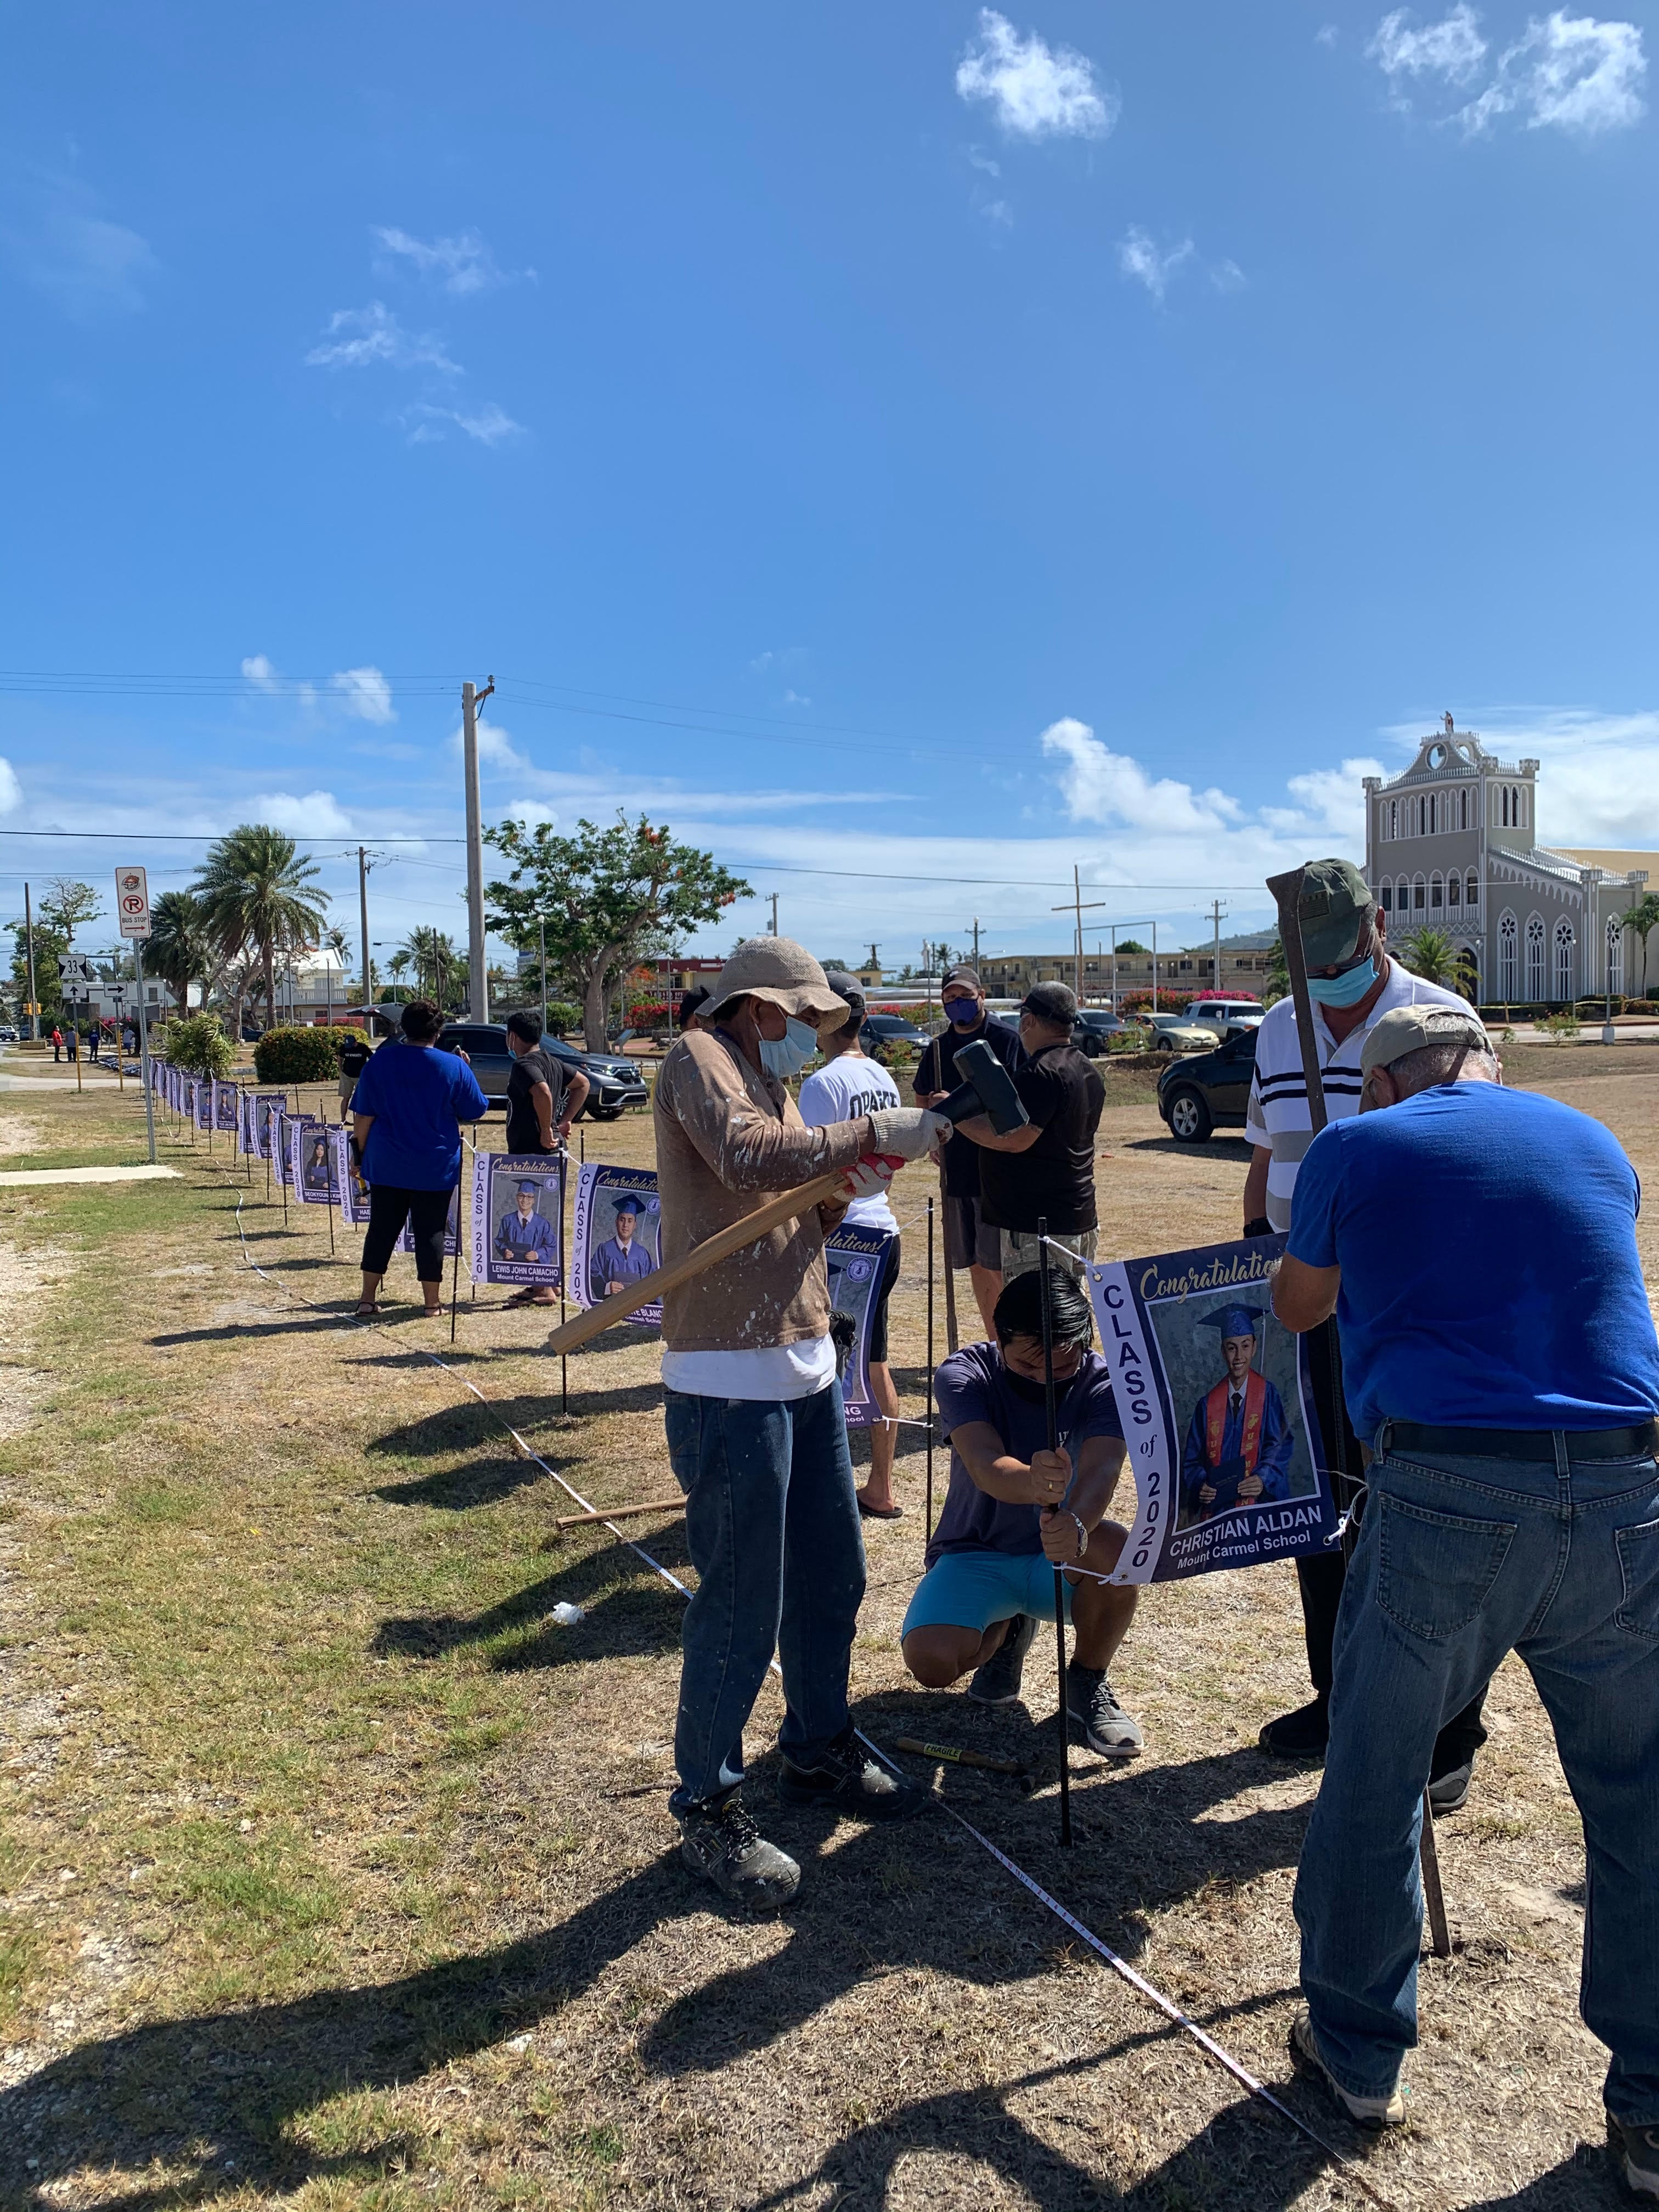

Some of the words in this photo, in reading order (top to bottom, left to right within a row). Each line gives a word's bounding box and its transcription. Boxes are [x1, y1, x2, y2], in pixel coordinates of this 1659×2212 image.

[67, 960, 78, 973] 33
[475, 1161, 485, 1215] CLASS
[475, 1218, 483, 1227] of
[577, 1173, 590, 1240] CLASS
[575, 1245, 583, 1256] of
[492, 1265, 510, 1273] LEWIS
[511, 1266, 527, 1274] JOHN
[528, 1267, 558, 1277] CAMACHO
[1103, 1284, 1153, 1425] CLASS
[1140, 1434, 1157, 1458] of
[1132, 1472, 1160, 1567] 2020
[1169, 1517, 1250, 1557] CHRISTIAN
[1255, 1505, 1323, 1536] ALDAN
[1177, 1552, 1211, 1570] Mount
[1212, 1539, 1260, 1558] Carmel
[1263, 1530, 1311, 1550] School
[926, 1745, 960, 1757] FRAGILE
